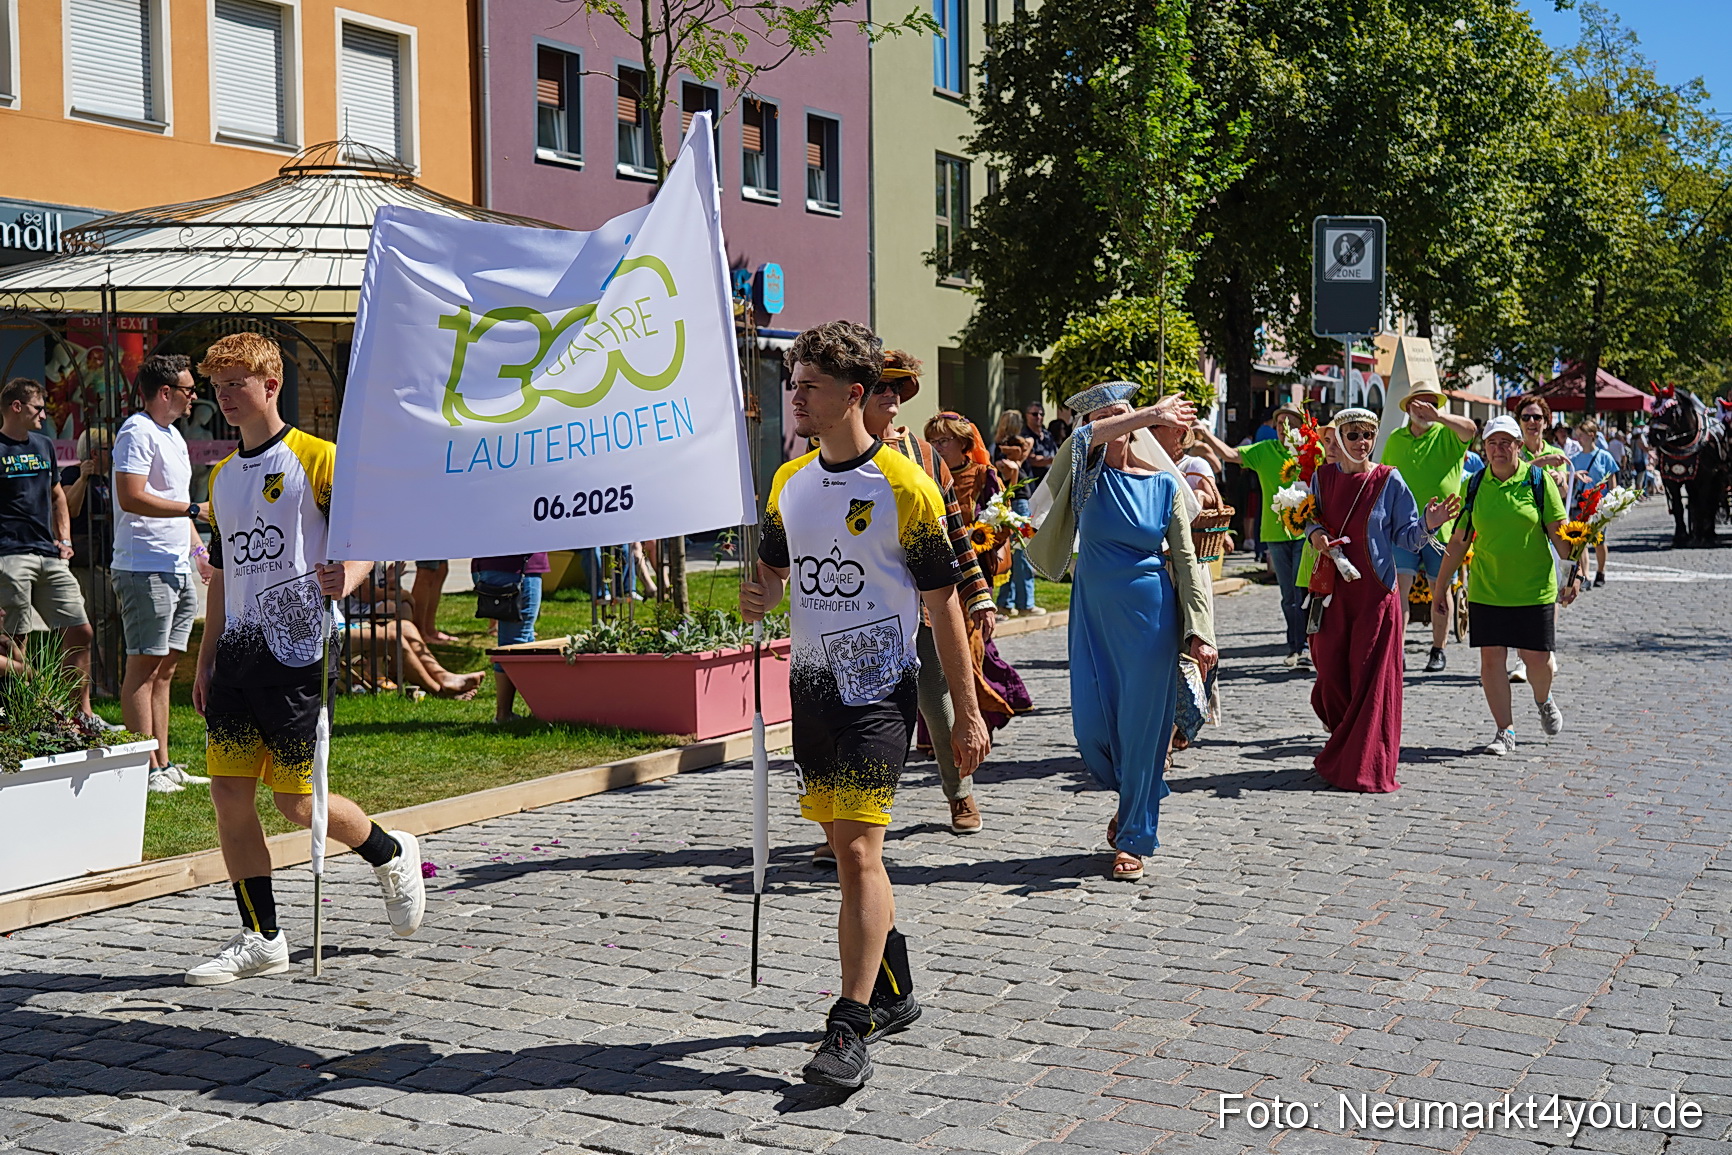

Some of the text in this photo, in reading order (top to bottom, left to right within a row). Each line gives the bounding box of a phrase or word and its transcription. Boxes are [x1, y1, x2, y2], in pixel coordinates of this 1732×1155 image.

[1336, 268, 1362, 279] ZONE
[546, 296, 660, 376] JAHRE
[444, 397, 695, 474] LAUTERHOFEN
[2, 453, 42, 465] UNDER
[5, 460, 51, 473] ARMOUR
[533, 484, 634, 521] 06.2025
[850, 501, 862, 512] SV
[252, 537, 276, 550] JAHRE
[823, 572, 854, 585] JAHRE
